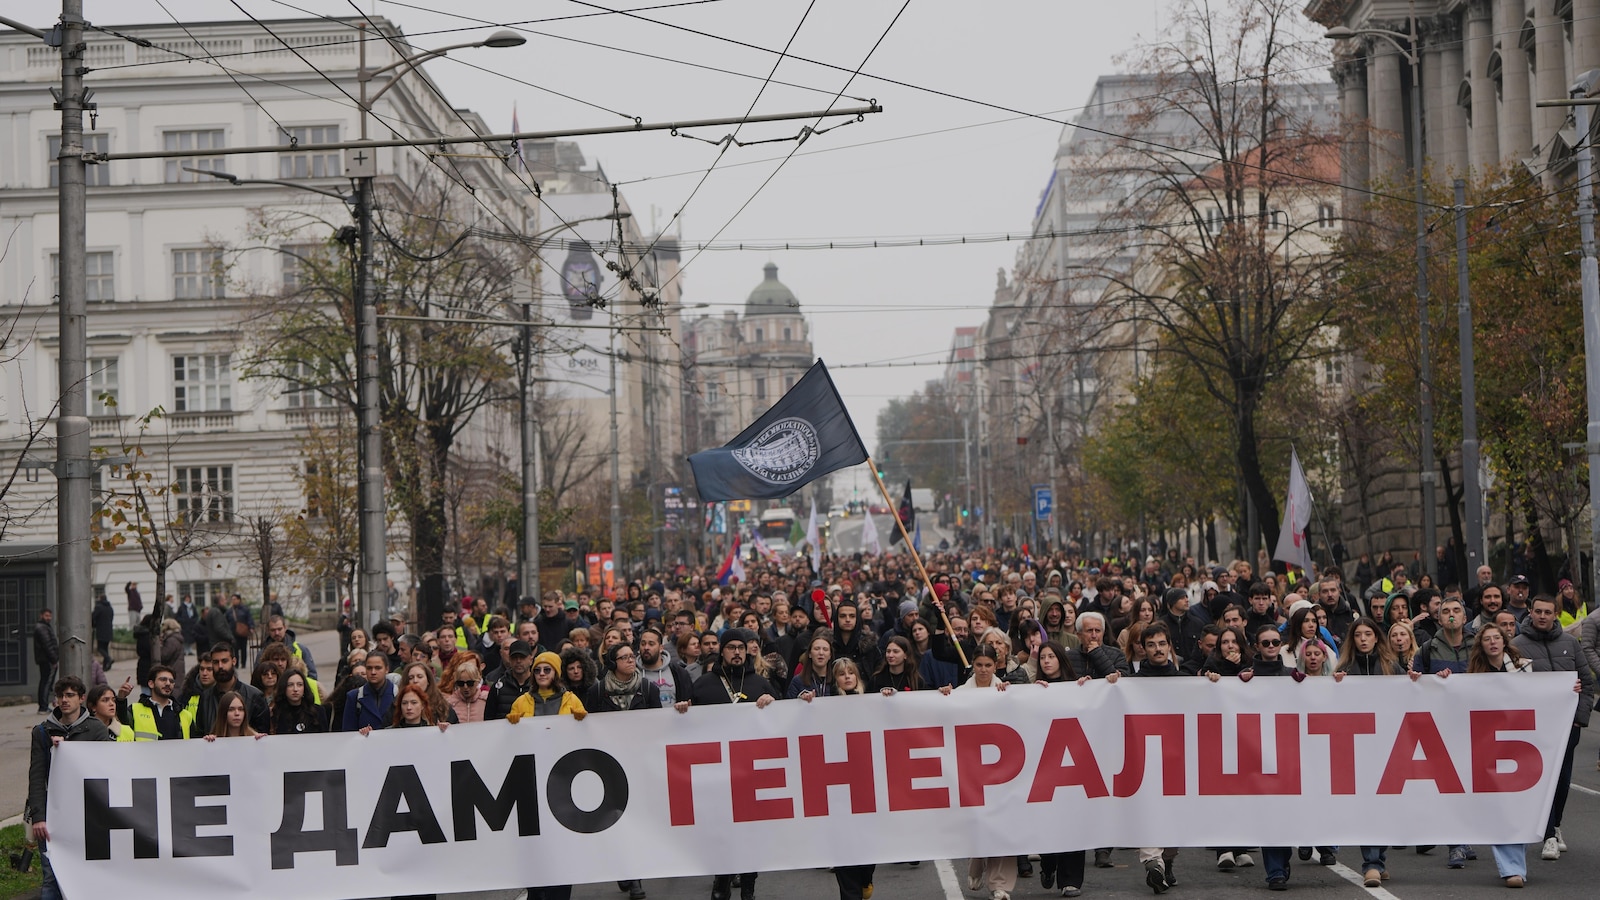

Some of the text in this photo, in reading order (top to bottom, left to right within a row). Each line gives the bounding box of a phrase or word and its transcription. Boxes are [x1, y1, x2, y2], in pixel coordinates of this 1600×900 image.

[1039, 495, 1047, 511] P
[84, 710, 1542, 869] НЕ ДАМО ГЕНЕРАЛШТАБ
